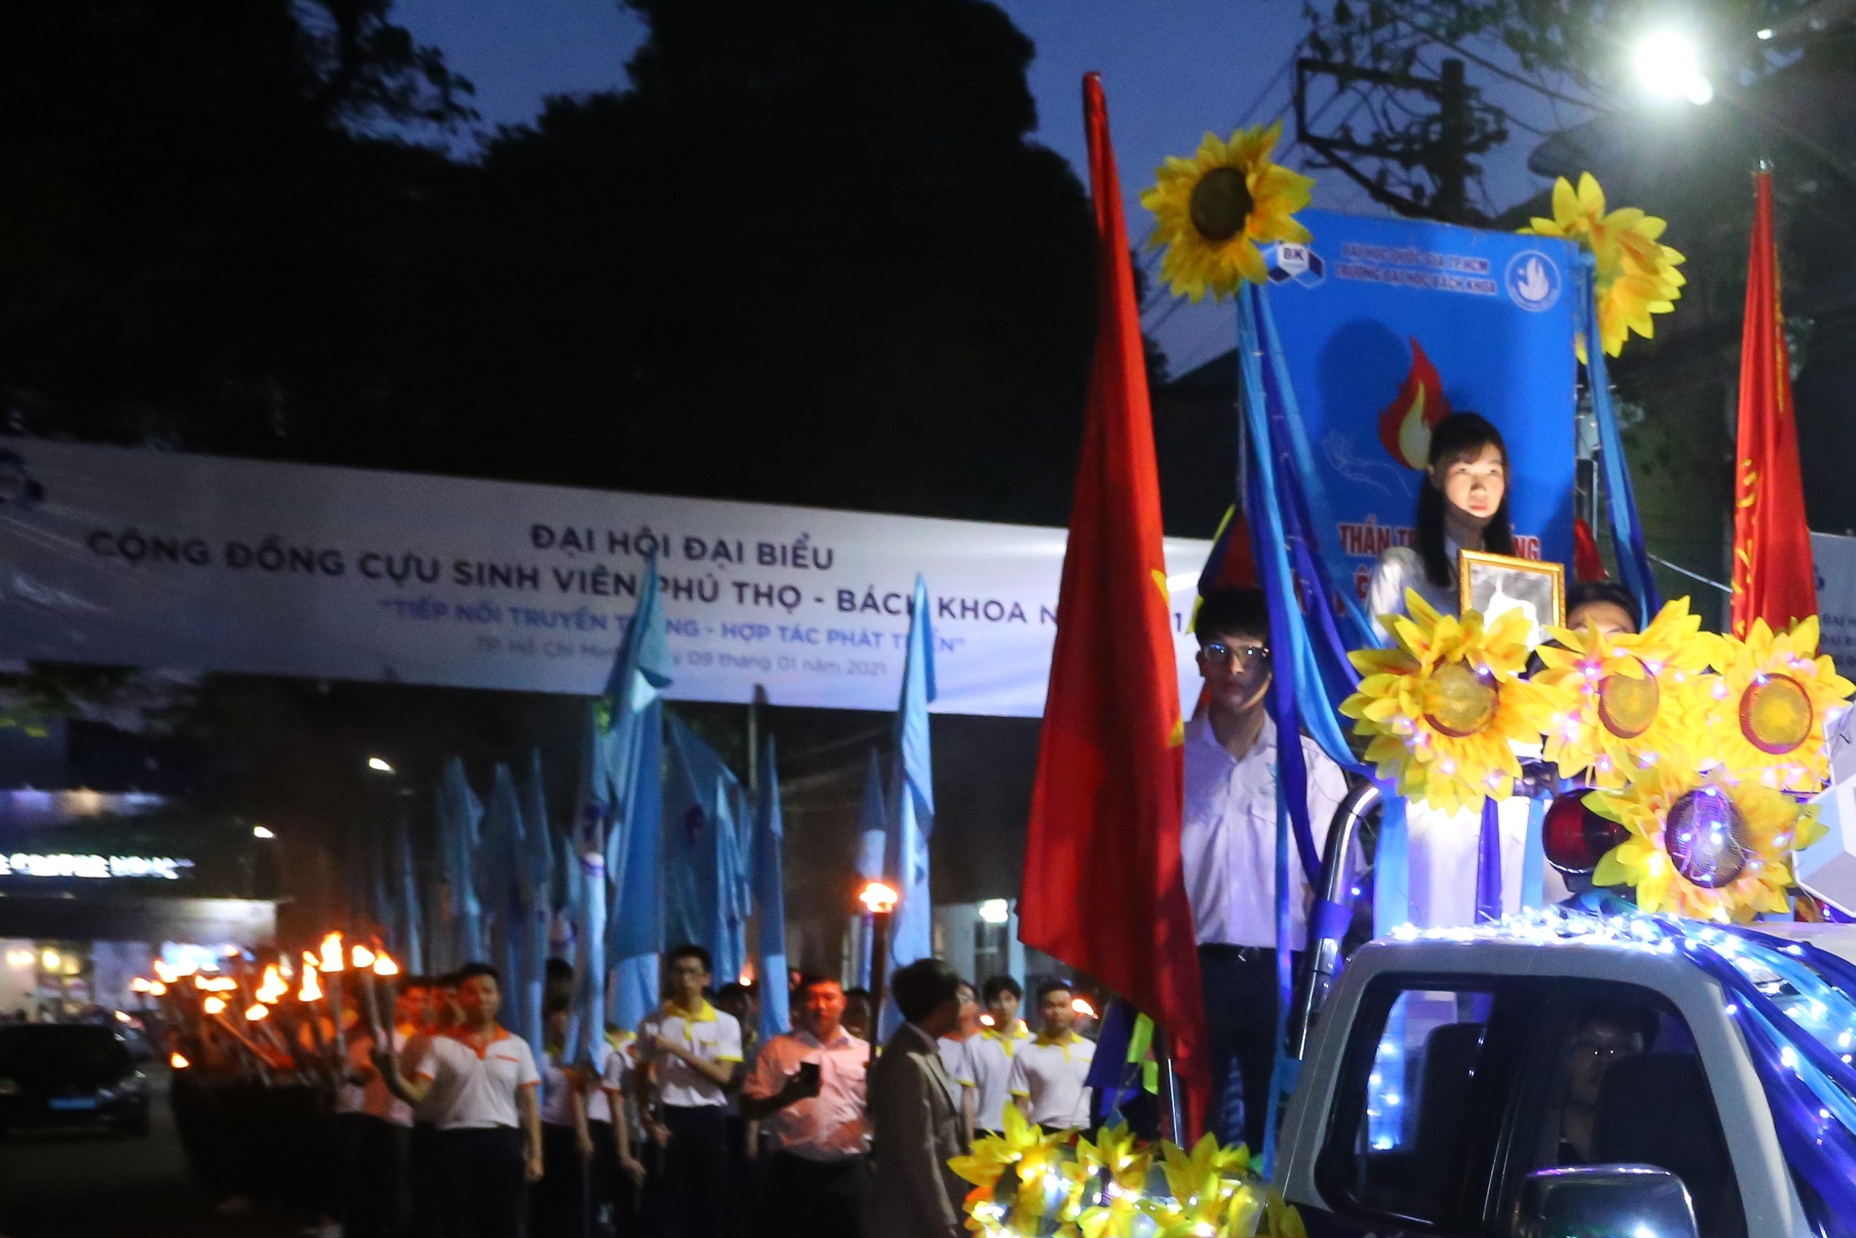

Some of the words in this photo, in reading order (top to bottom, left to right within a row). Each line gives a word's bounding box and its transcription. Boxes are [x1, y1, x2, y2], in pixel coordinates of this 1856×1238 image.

[87, 526, 210, 568] CỘNG
[224, 533, 346, 576] ĐỒNG
[357, 550, 441, 587] CỰU
[453, 559, 540, 591] SINH
[552, 563, 637, 597] VIÊN
[731, 580, 802, 617] THỌ
[937, 596, 1029, 625] KHOA
[531, 524, 595, 558] ĐẠI
[683, 537, 744, 570] ĐẠI
[756, 530, 834, 571] BIỂU
